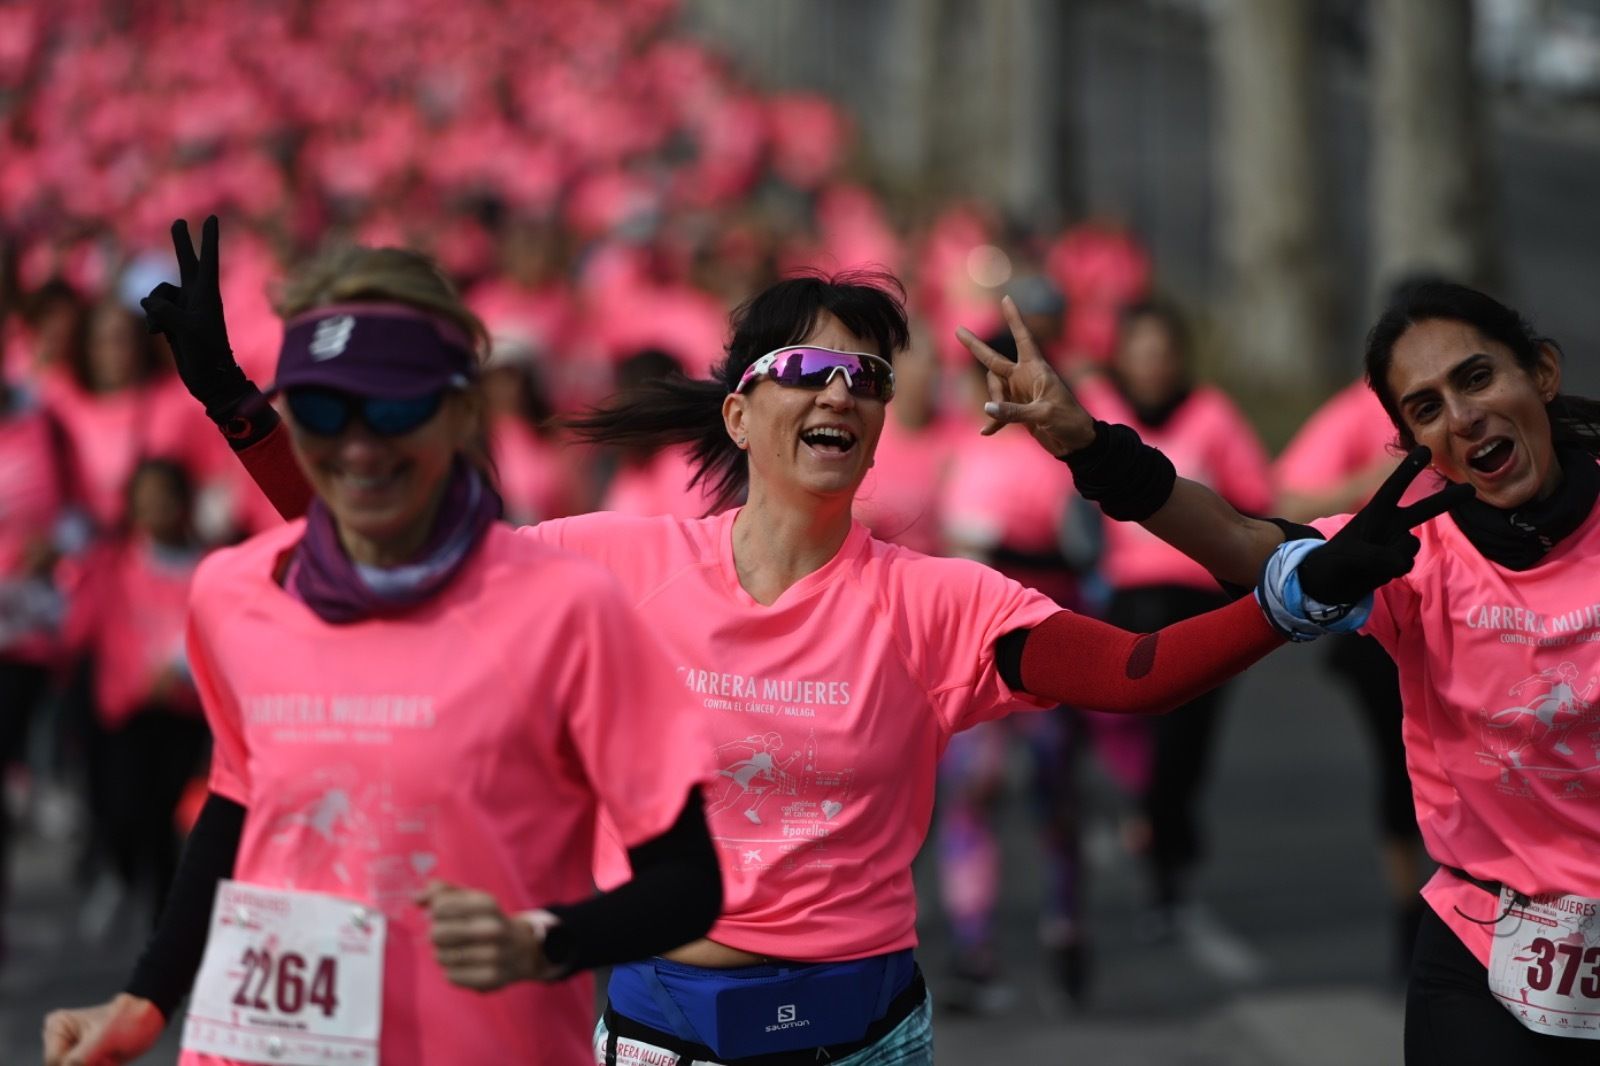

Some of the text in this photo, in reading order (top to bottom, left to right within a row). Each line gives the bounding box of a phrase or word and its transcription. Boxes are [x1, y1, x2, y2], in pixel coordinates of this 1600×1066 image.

[1466, 605, 1548, 632] CARRERA
[677, 666, 850, 705] ARRERA MUJERES
[703, 698, 732, 711] CONTRA
[734, 700, 742, 712] EL
[232, 946, 340, 1019] 2264
[1527, 937, 1600, 999] 373
